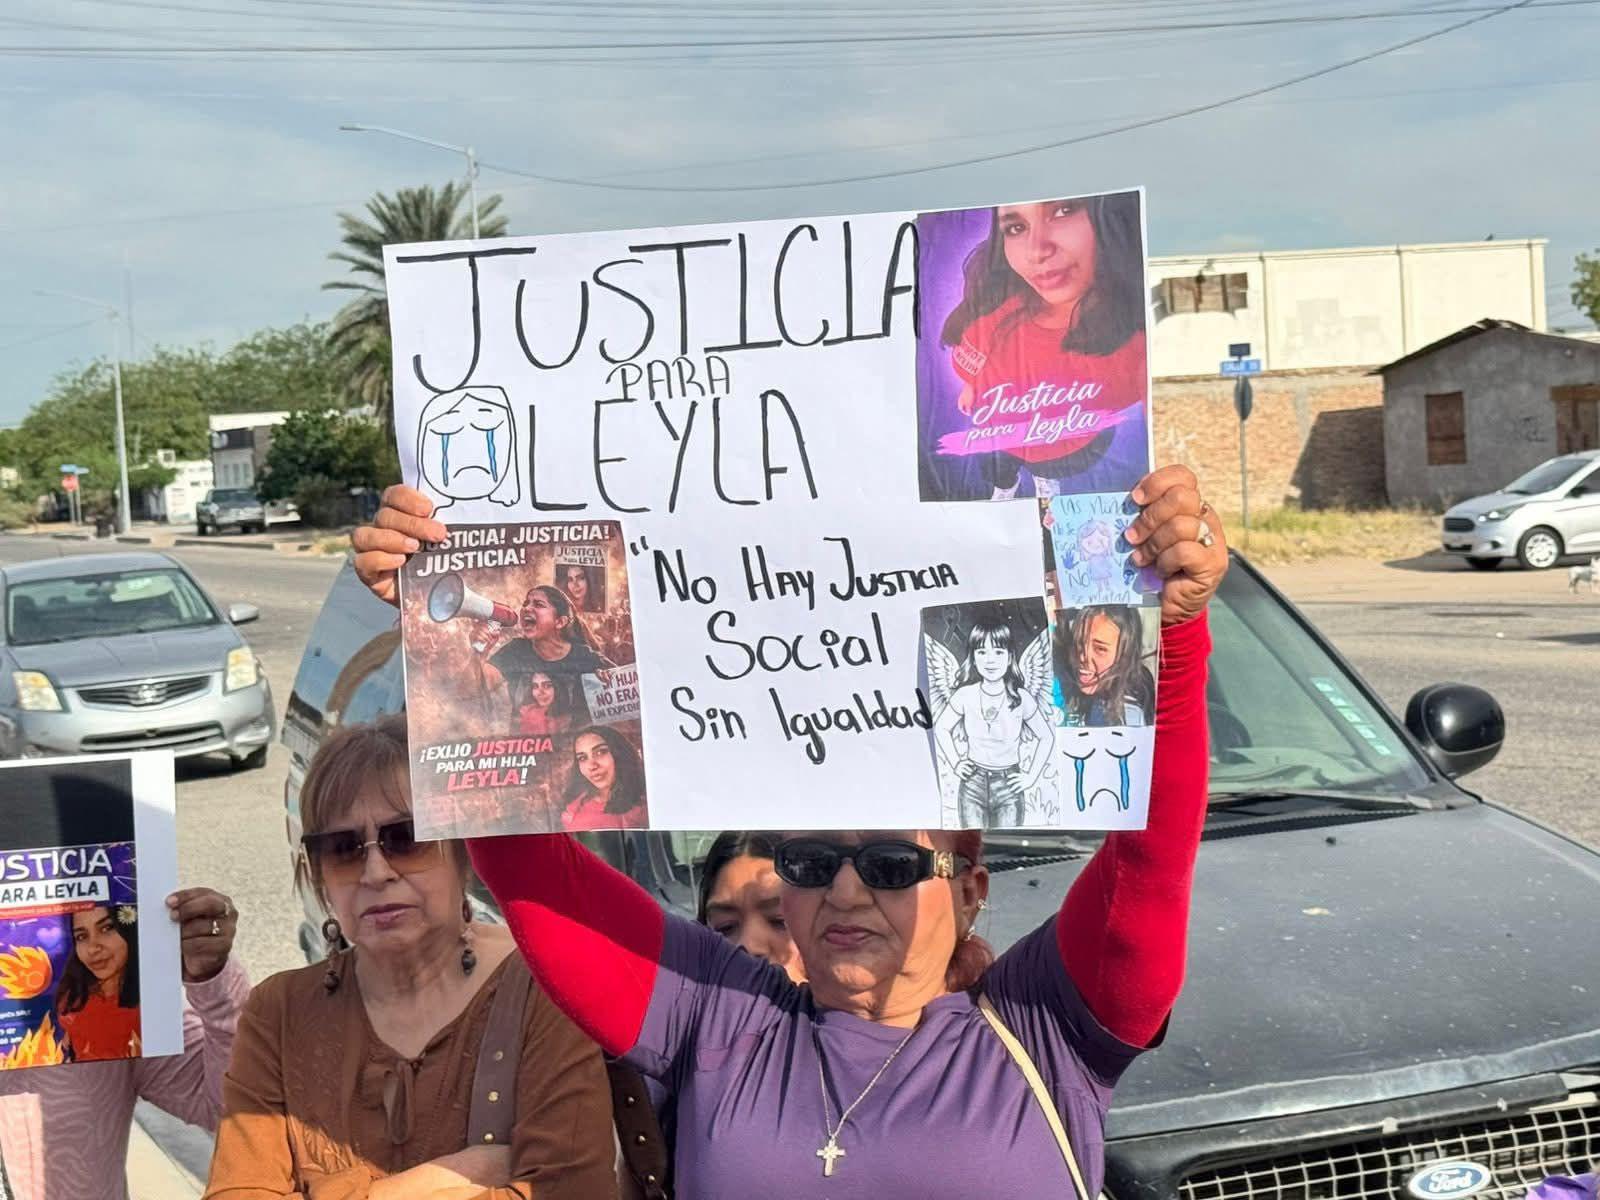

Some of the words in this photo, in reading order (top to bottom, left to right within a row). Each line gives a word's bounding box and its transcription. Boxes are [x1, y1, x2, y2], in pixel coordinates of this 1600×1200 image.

[396, 221, 920, 393] JUSTICIA
[605, 355, 730, 401] PARA
[972, 380, 1103, 426] Justicia
[965, 423, 1016, 449] para
[1022, 403, 1101, 444] Leyla
[529, 389, 818, 514] LEYLA
[426, 527, 506, 551] STICIA!
[512, 524, 610, 545] JUSTICIA!
[416, 547, 526, 577] JUSTICIA!
[671, 686, 747, 742] Sin
[436, 761, 474, 774] PARA
[478, 757, 497, 770] MI
[501, 755, 537, 769] HIJA
[473, 738, 554, 758] JUSTICIA
[447, 767, 528, 792] LEYLA!
[45, 881, 100, 899] LEYLA
